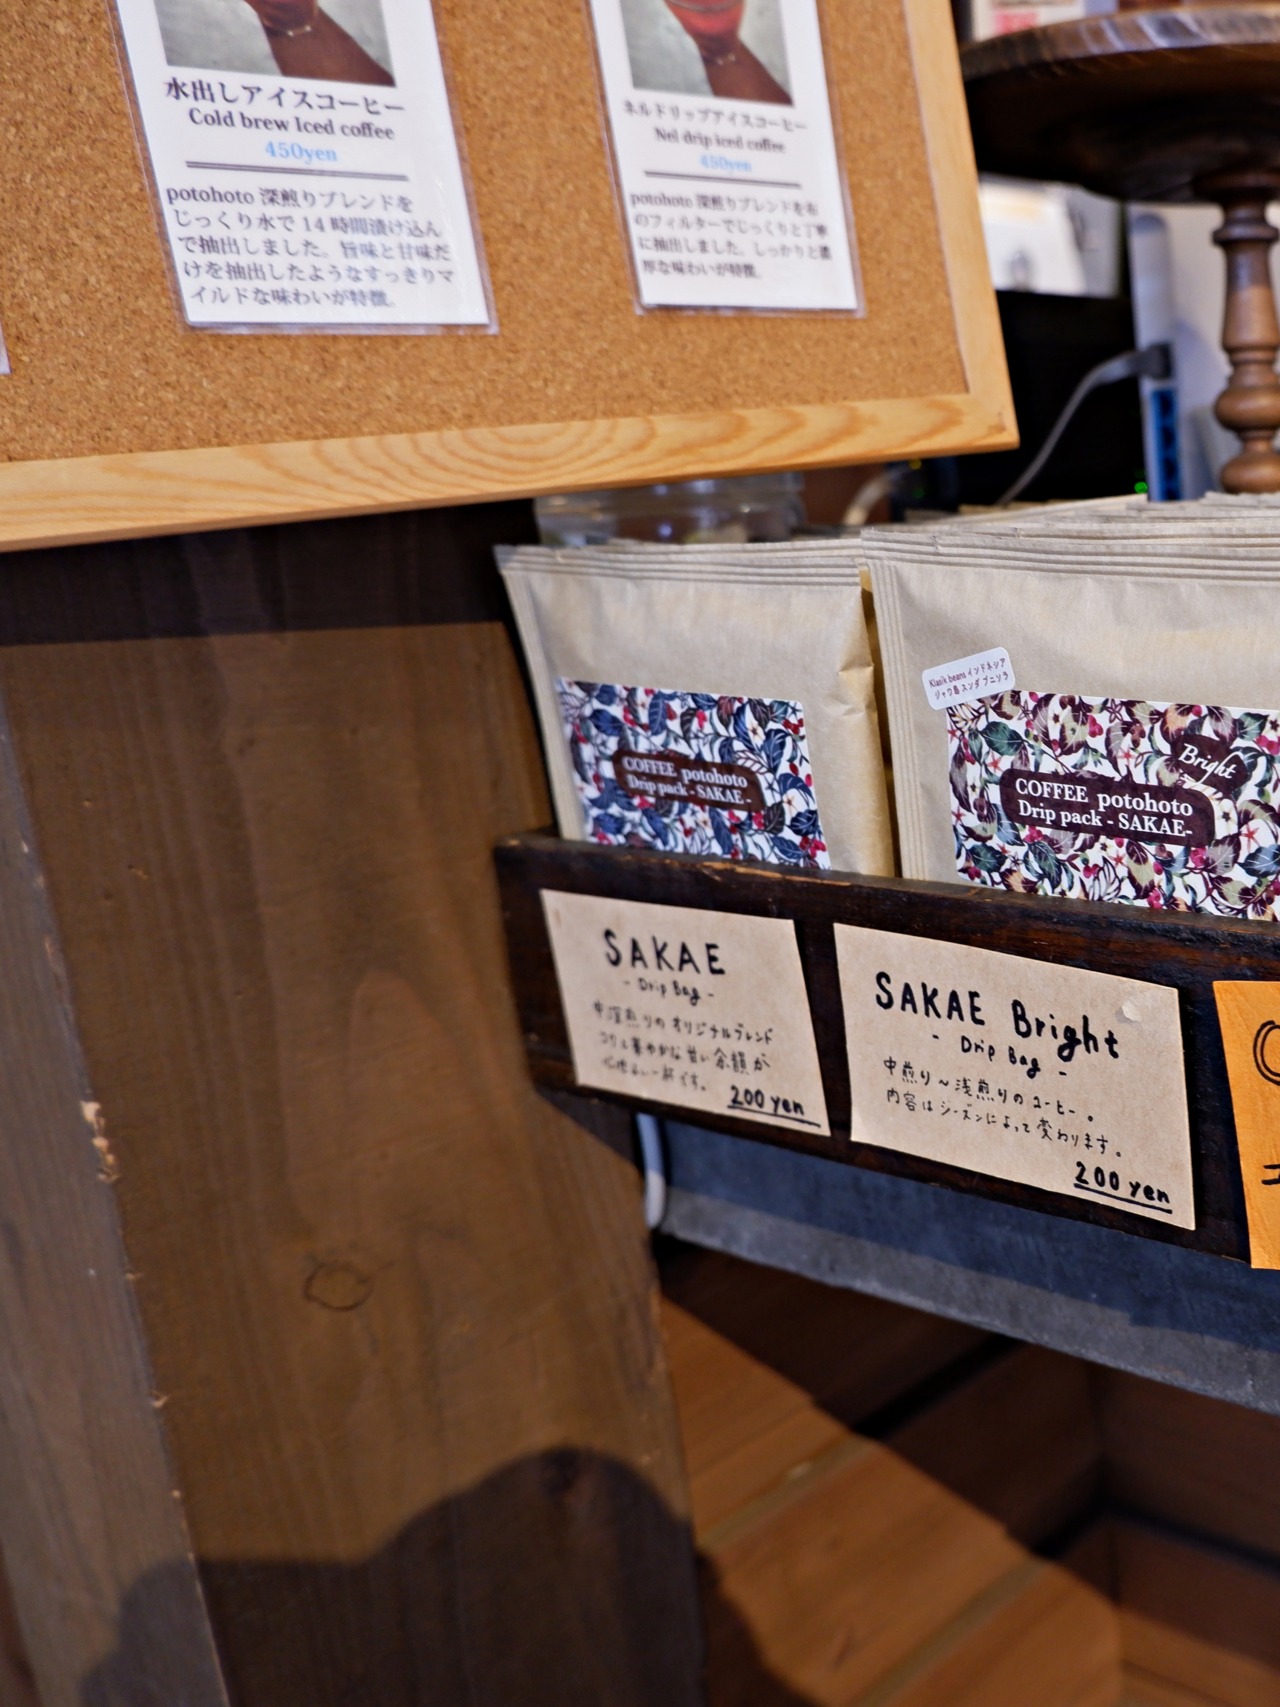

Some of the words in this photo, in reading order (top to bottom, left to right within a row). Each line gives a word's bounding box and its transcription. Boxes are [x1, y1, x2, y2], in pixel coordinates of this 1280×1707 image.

[163, 77, 405, 115] 水出しアイスコーヒー
[189, 108, 236, 128] Cold
[240, 111, 290, 132] brew
[295, 116, 335, 136] Iced
[341, 121, 395, 140] coffee
[624, 101, 808, 132] ネルドリップアイスコーヒー
[265, 141, 338, 164] 450yen
[654, 128, 679, 143] Nel
[684, 131, 713, 149] drip
[715, 135, 744, 149] iced
[747, 138, 786, 153] coffee
[166, 186, 255, 204] potohoto
[259, 188, 414, 213] 深煎りブレンドを
[630, 193, 692, 208] potohoto
[929, 676, 947, 687] Klasik
[947, 672, 967, 682] beans
[967, 657, 1006, 677] インドネシア
[622, 756, 677, 777] COFFEE
[681, 766, 748, 788] potohoto
[1177, 743, 1237, 785] Bright
[627, 774, 657, 796] Drip
[657, 780, 687, 798] pack
[1015, 777, 1089, 803] COFFEE
[1097, 791, 1193, 817] potohoto
[1018, 800, 1056, 825] Drip
[1060, 809, 1102, 830] pack
[604, 929, 726, 975] SAKAE
[639, 978, 667, 998] Drip
[672, 980, 701, 1006] Bag
[875, 971, 985, 1026] SAKAE
[1011, 998, 1120, 1062] Bright
[960, 1035, 996, 1062] Drip
[1008, 1046, 1042, 1079] Bag
[731, 1085, 765, 1109] 200
[770, 1094, 805, 1116] yen
[1075, 1161, 1119, 1191] 200
[1128, 1180, 1171, 1204] yen
